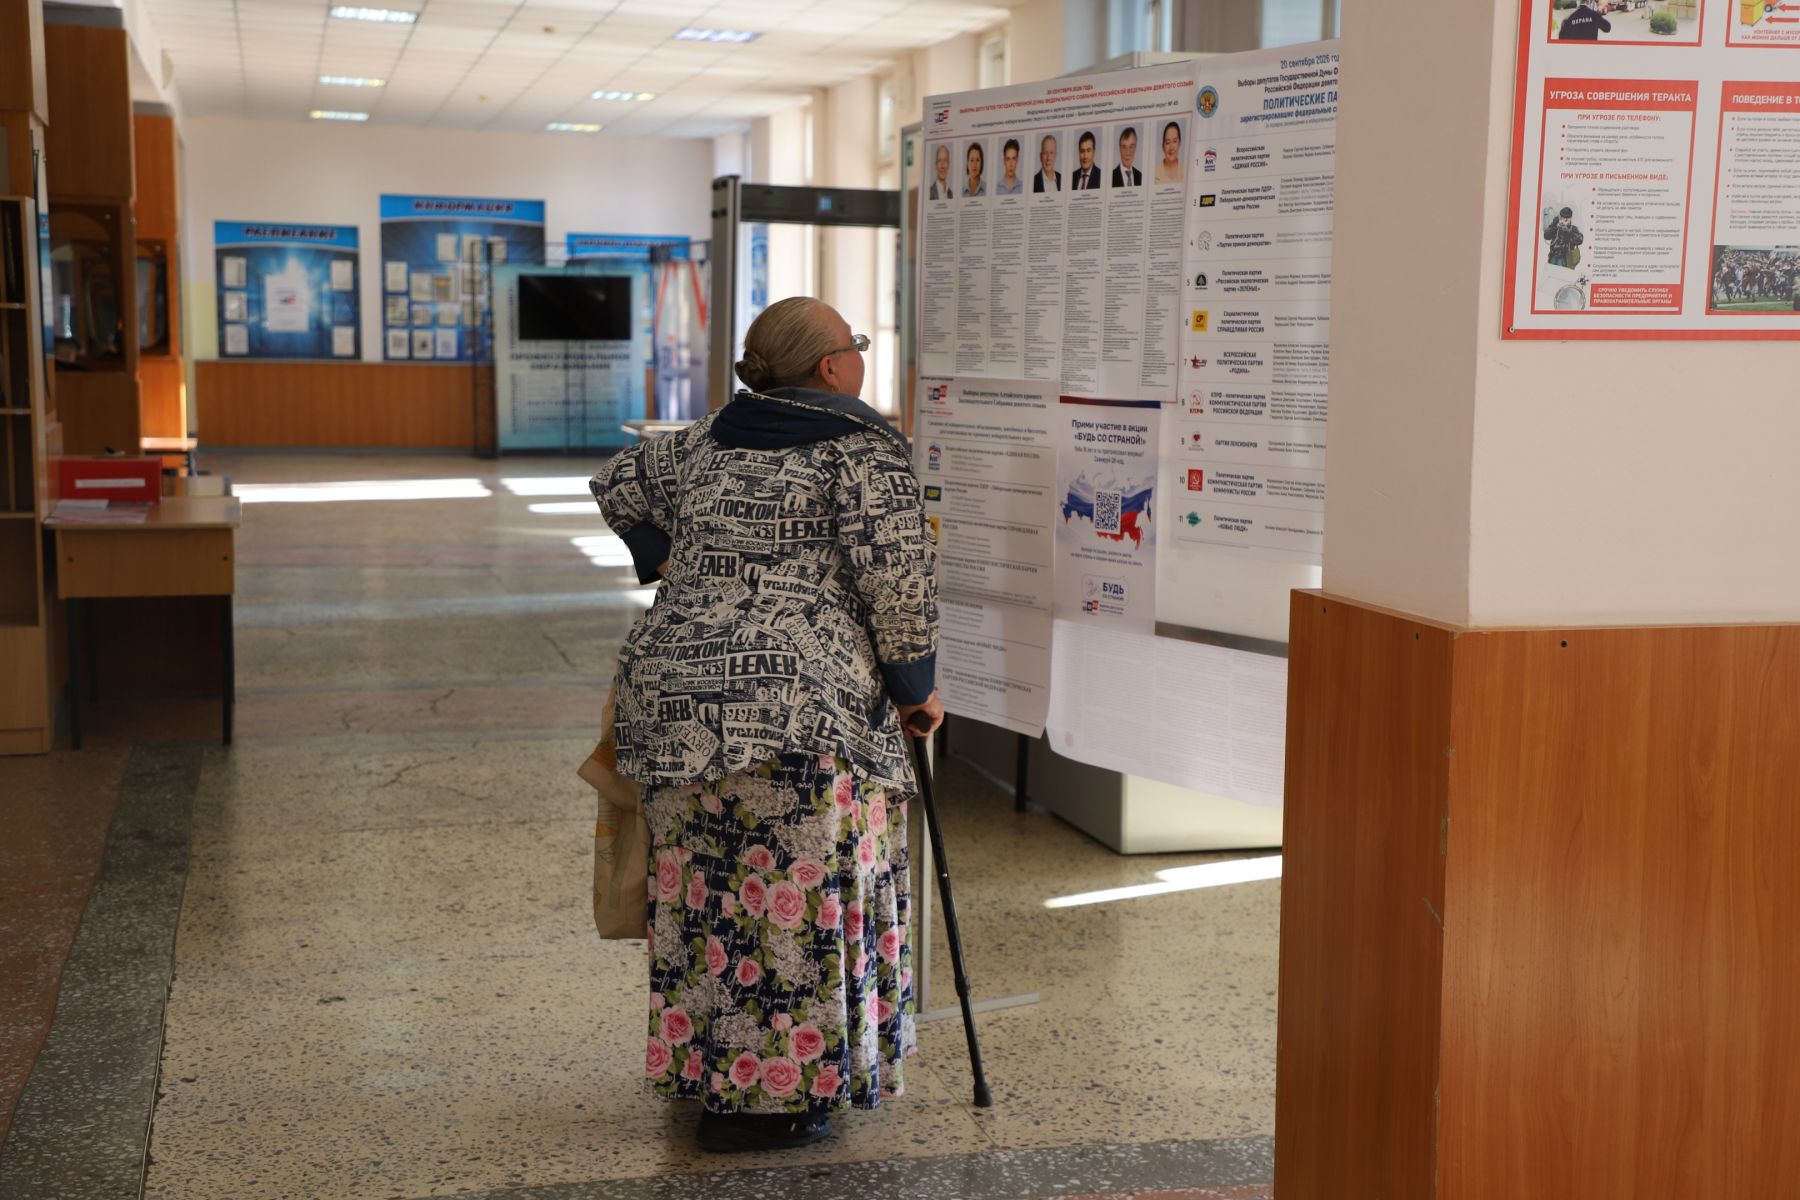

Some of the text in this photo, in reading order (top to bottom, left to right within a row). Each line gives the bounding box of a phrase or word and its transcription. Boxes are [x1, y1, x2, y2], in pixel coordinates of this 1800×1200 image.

[1572, 17, 1592, 25] ОХРАНА
[1289, 58, 1315, 69] сентября
[1238, 69, 1333, 87] Выборы депутатов Государственной Думы
[1265, 80, 1320, 93] Российской Федерации
[1264, 94, 1326, 110] ПОЛИТИЧЕСКИЕ
[1550, 91, 1692, 102] УГРОЗА СОВЕРШЕНИЯ ТЕРАКТА
[1733, 95, 1792, 105] ПОВЕДЕНИЕ В
[1295, 106, 1332, 118] федеральные
[1231, 154, 1256, 162] политическая
[414, 200, 514, 213] ИНФОРМАЦИЯ
[244, 226, 337, 240] РАСПИСАНИЕ
[1224, 351, 1256, 359] ВСЕРОССИЙСКАЯ
[1072, 420, 1094, 430] Прими
[1096, 422, 1122, 431] участие
[1128, 425, 1148, 433] акции
[1075, 432, 1096, 442] «БУДЬ
[1097, 434, 1107, 442] СО
[1208, 479, 1248, 488] КОММУНИСТИЧЕСКАЯ
[1214, 488, 1240, 496] КОММУНИСТЫ
[1214, 515, 1239, 523] Политическая
[1103, 582, 1125, 595] БУДЬ
